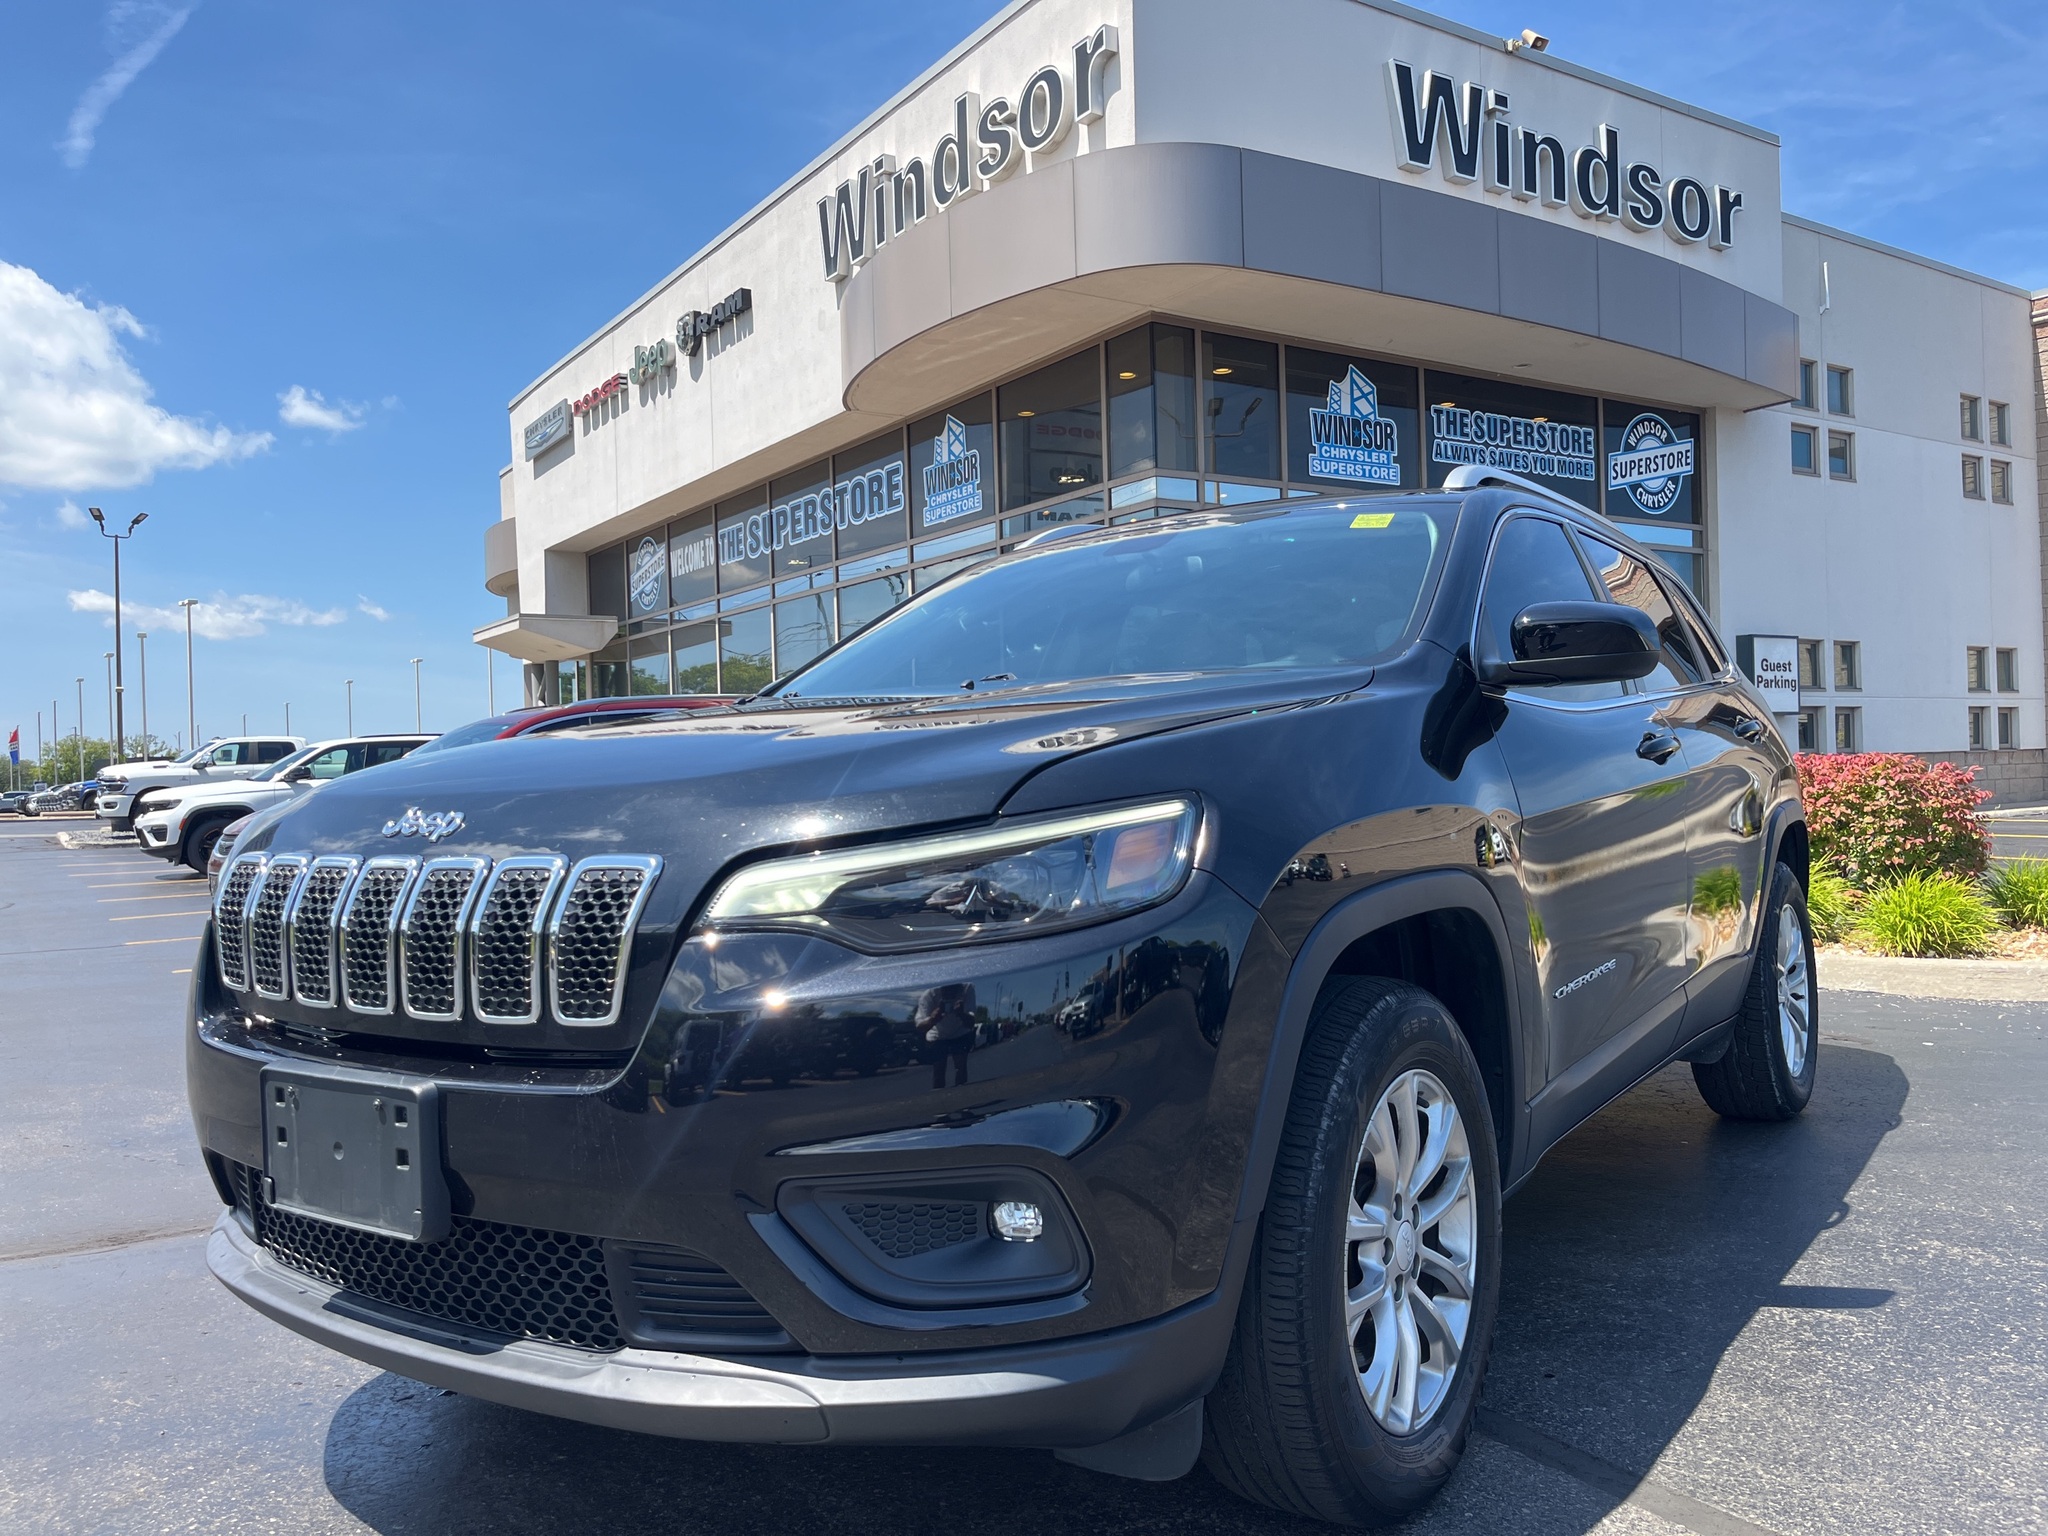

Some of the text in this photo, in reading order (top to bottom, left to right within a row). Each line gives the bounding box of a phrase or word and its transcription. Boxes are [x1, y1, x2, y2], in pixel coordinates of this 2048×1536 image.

[817, 24, 1115, 282] Windsor
[1385, 58, 1743, 250] Windsor
[696, 288, 748, 335] RAM
[629, 338, 672, 385] Jeep
[574, 374, 625, 417] DODGE
[526, 406, 563, 439] CHRYSLER
[1312, 412, 1395, 452] WINDSOR
[1432, 406, 1594, 457] THE SUPERSTORE
[1627, 421, 1668, 447] WINDSOR
[925, 453, 979, 496] WINDSOR
[1313, 460, 1397, 480] SUPERSTORE
[1321, 446, 1388, 464] CHRYSLER
[1434, 441, 1594, 480] ALWAYS SAVES YOU MORE!
[1612, 449, 1691, 480] SUPERSTORE
[925, 496, 980, 521] SUPERSTORE
[930, 484, 974, 506] CHRYSLER
[1636, 480, 1676, 508] CHRYSLER
[670, 461, 903, 578] WELCOME TO THE SUPERSTORE
[631, 553, 665, 594] SUPERSTORE
[1756, 675, 1797, 692] Parking
[1761, 658, 1792, 672] Guest
[382, 806, 465, 843] Jeep
[1554, 958, 1617, 999] CHEROKEE
